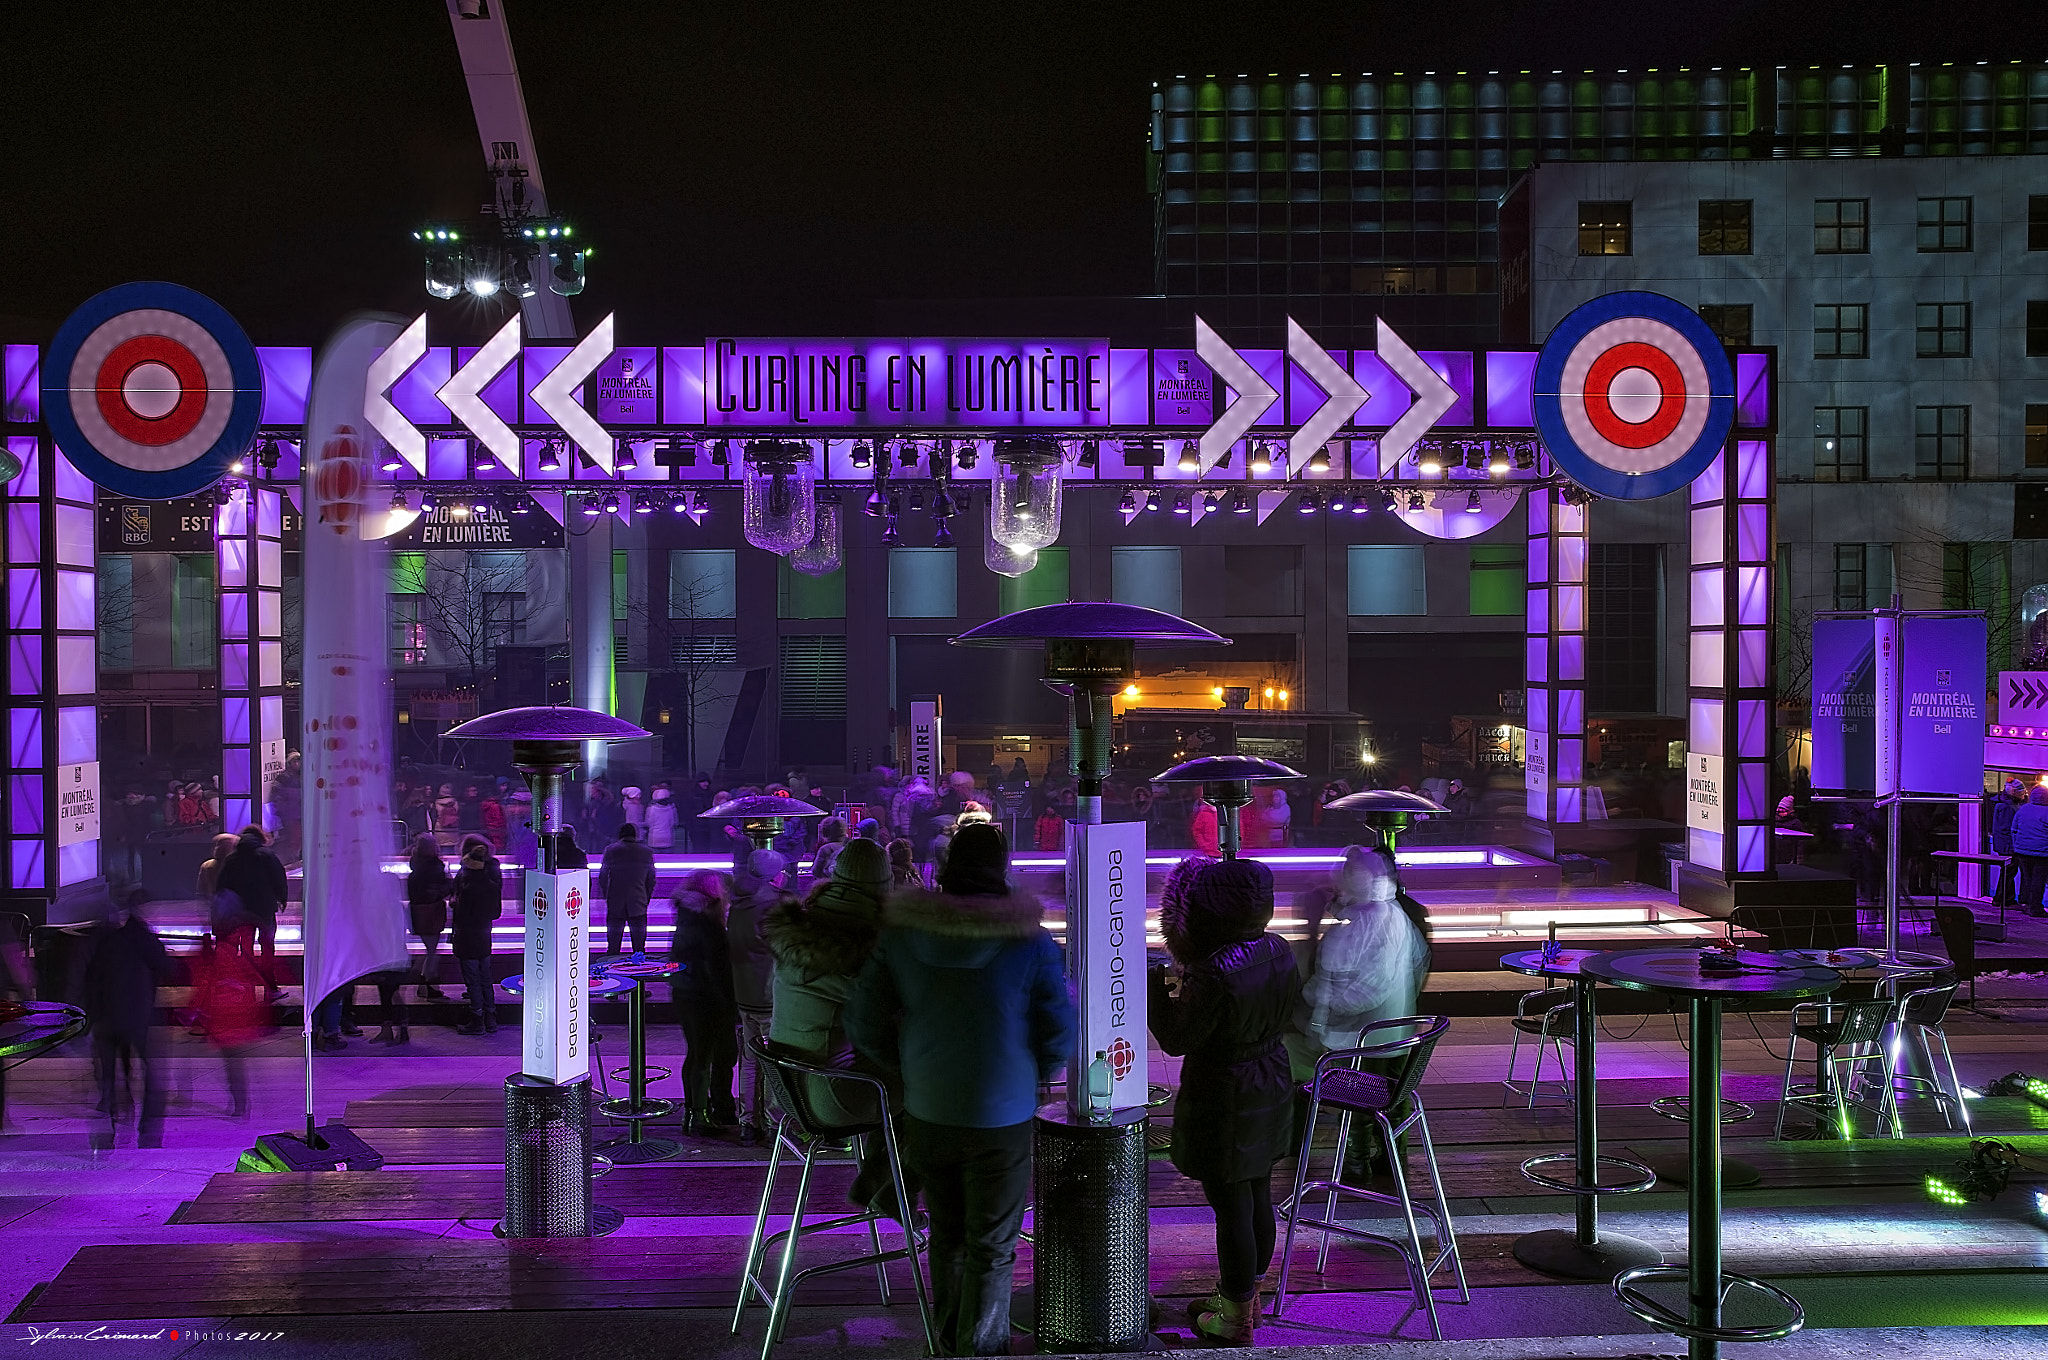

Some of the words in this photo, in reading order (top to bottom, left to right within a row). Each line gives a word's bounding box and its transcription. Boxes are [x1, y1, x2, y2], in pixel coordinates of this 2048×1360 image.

[601, 376, 652, 389] MONTRÉAL
[716, 339, 867, 423] CURLING
[887, 354, 926, 412] EN
[947, 347, 1101, 412] LUMIÈRE
[1158, 378, 1208, 390] MONTRÉAL
[600, 389, 612, 399] EN
[614, 388, 654, 399] LUMIÈRE
[1157, 390, 1169, 401] EN
[1171, 390, 1210, 401] LUMIÈRE
[620, 405, 634, 413] Bell
[1177, 406, 1191, 415] Bell
[125, 532, 148, 542] RBC
[422, 526, 442, 543] EN
[446, 524, 513, 543] LUMIÈRE
[1911, 691, 1975, 706] MONTRÉAL
[1818, 706, 1832, 717] EN
[1834, 705, 1875, 718] LUMIÈR
[1909, 705, 1924, 717] EN
[1926, 705, 1978, 719] LUMIÈRE
[1841, 723, 1858, 733] Bell
[1934, 724, 1951, 734] Bell
[1478, 753, 1511, 763] TRUCK
[1690, 778, 1718, 794] MONTRÉAL
[62, 788, 94, 806] MONTRÉAL
[1689, 791, 1696, 802] EN
[61, 806, 69, 819] EN
[70, 802, 96, 817] LUMIÈRE
